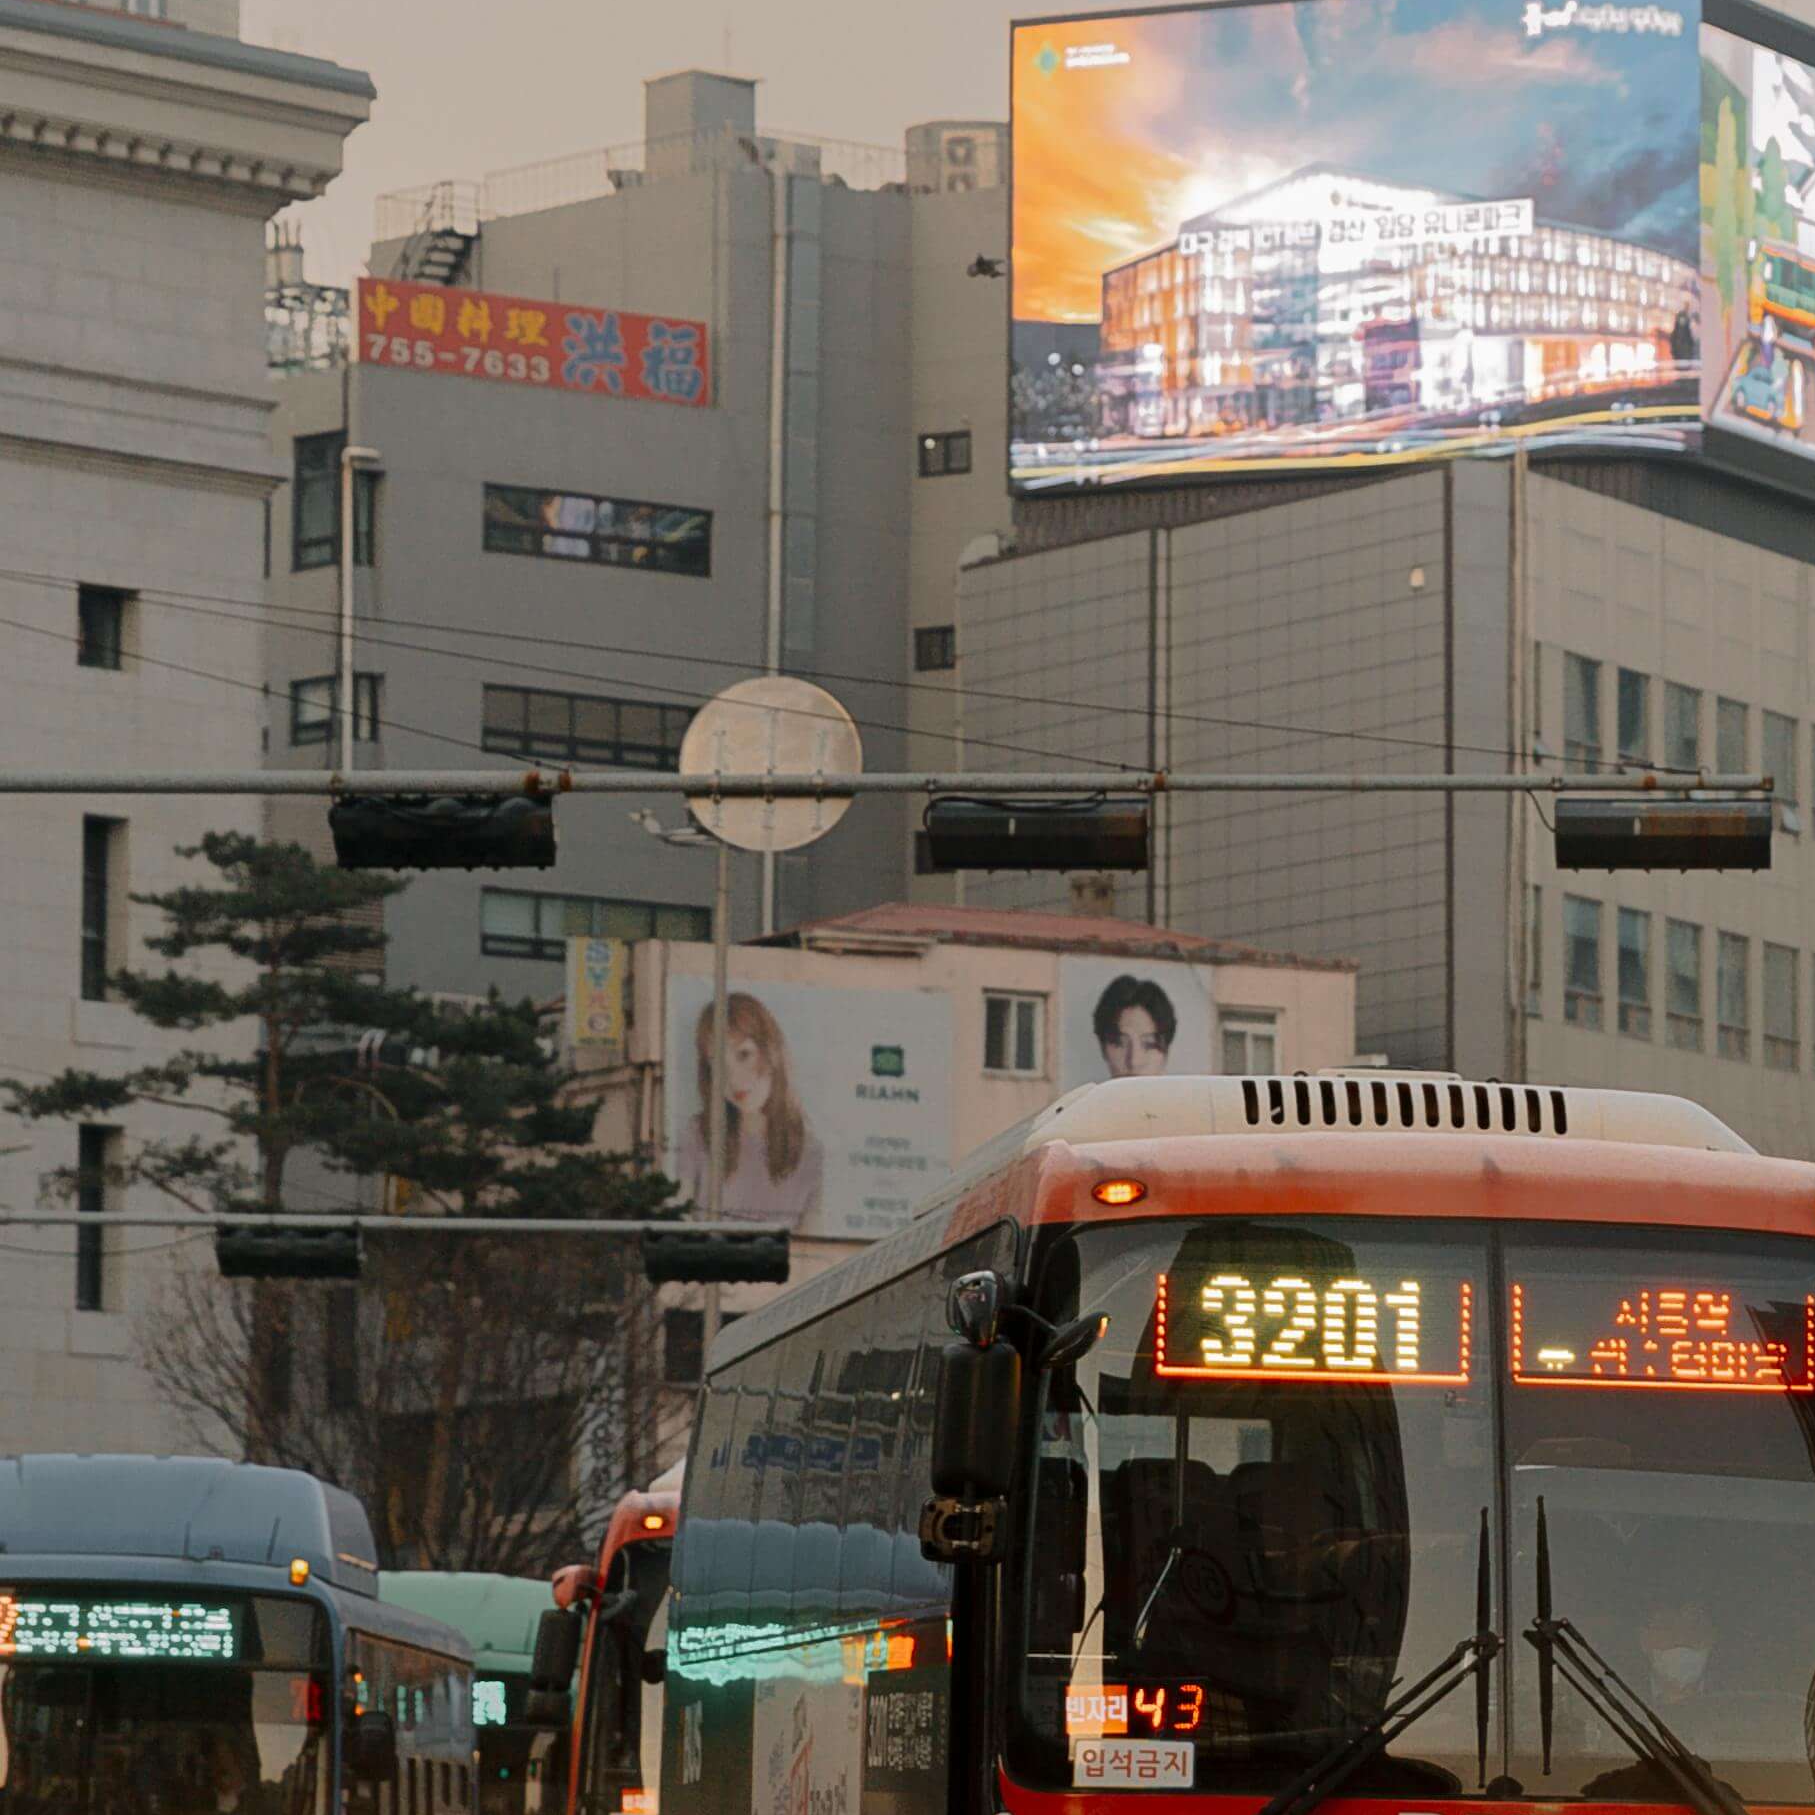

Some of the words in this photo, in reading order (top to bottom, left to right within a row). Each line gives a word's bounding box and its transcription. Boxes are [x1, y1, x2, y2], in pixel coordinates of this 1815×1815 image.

[365, 334, 551, 384] 755-7633
[1200, 1274, 1421, 1370] 3201
[1066, 1695, 1128, 1723] 빈자리
[1134, 1685, 1203, 1730] 43
[1082, 1748, 1188, 1778] 입석금지
